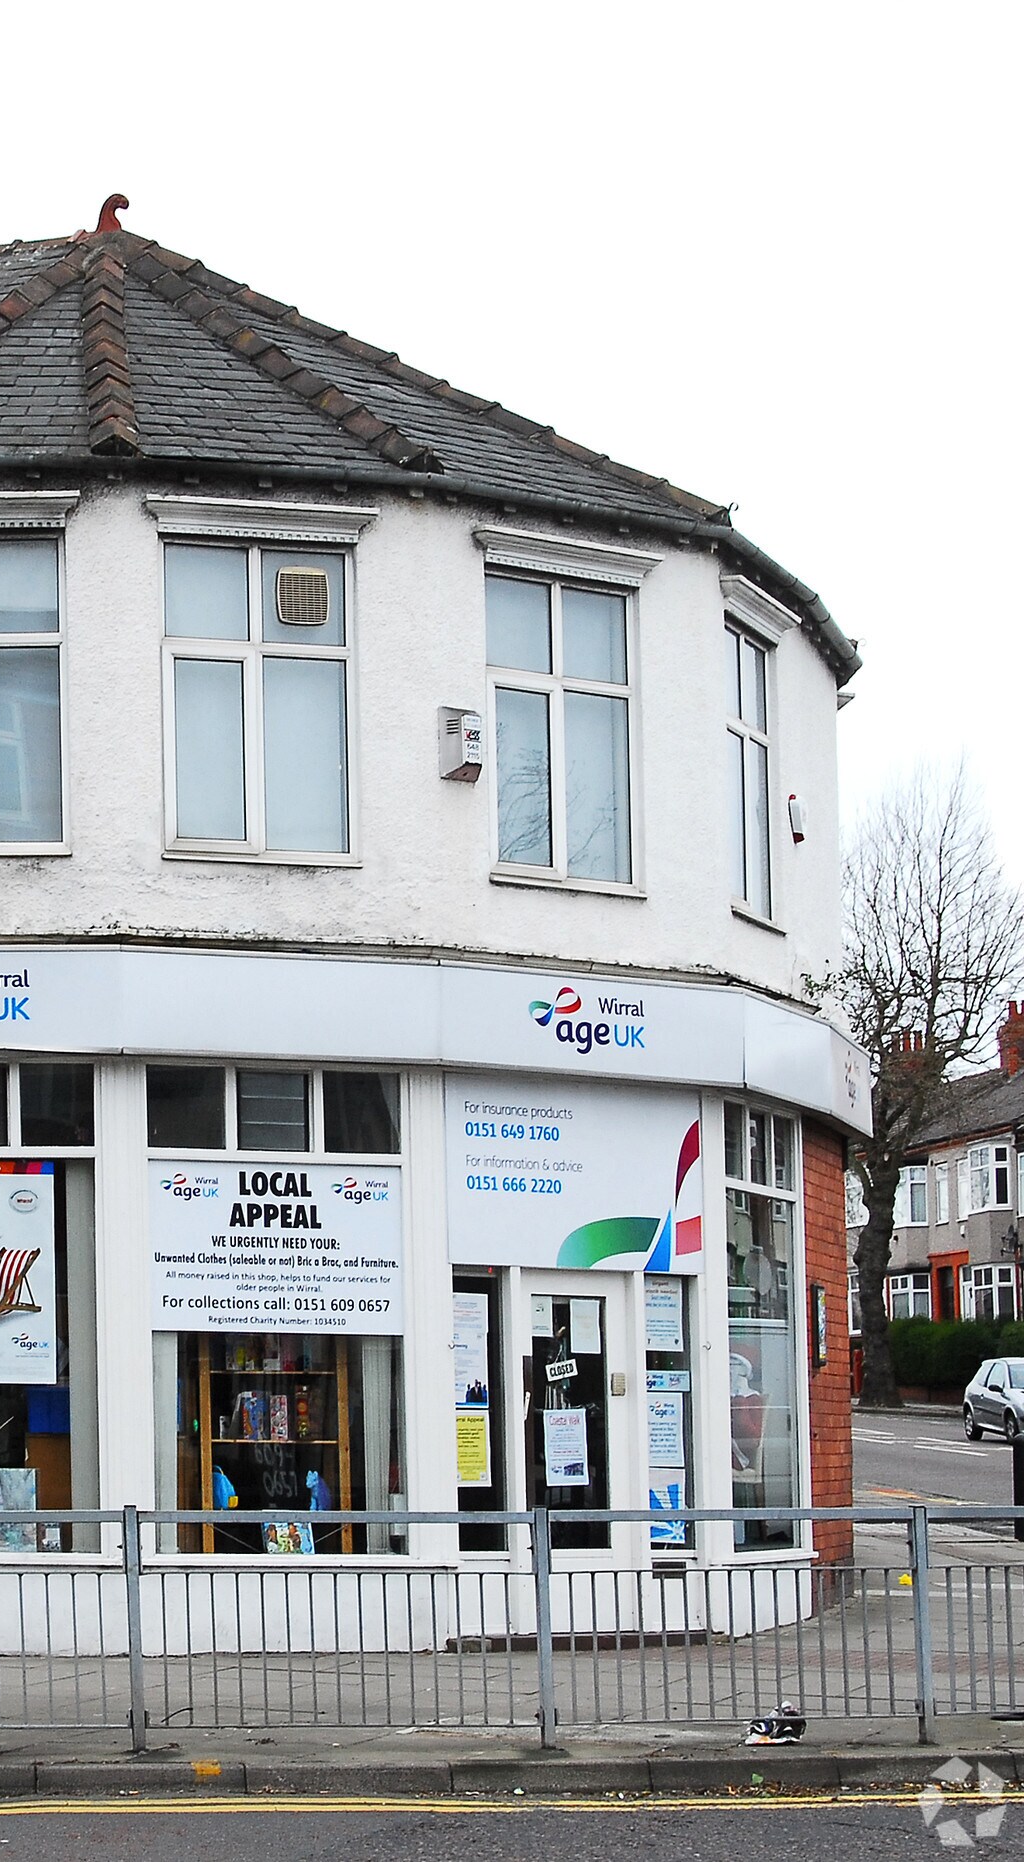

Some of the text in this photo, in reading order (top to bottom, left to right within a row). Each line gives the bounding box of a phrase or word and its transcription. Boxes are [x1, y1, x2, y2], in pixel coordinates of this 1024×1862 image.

[598, 997, 645, 1017] Wirral
[556, 1020, 645, 1055] age UK
[464, 1101, 573, 1120] For insurance products
[465, 1121, 560, 1141] 0151 649 1760
[466, 1155, 583, 1173] For information & advice
[195, 1176, 218, 1185] Wirral
[238, 1171, 312, 1198] LOCAL
[365, 1180, 388, 1189] Wirral
[467, 1175, 562, 1194] 0151 666 2220
[173, 1186, 219, 1201] age UK
[344, 1190, 389, 1204] age UK
[229, 1202, 322, 1229] APPEAL
[211, 1235, 340, 1250] WE URGENTLY NEED YOUR:
[154, 1252, 399, 1269] Unwanted Clothes (saleable or not) Bric a Brac, and Furniture.
[178, 1273, 205, 1281] money
[207, 1272, 230, 1280] raised
[232, 1272, 240, 1280] in
[257, 1273, 278, 1283] shop,
[280, 1274, 300, 1283] helps
[302, 1274, 311, 1282] to
[312, 1274, 331, 1282] fund
[236, 1284, 257, 1292] older
[258, 1284, 285, 1293] people
[296, 1284, 323, 1293] Wirral.
[163, 1295, 390, 1312] For collections call: 0151 609 0657
[208, 1315, 346, 1326] Registered Charity Number: 1034510
[20, 1342, 38, 1350] age
[549, 1363, 574, 1377] CLOSED
[646, 1380, 656, 1388] ge
[263, 1471, 298, 1498] 0657
